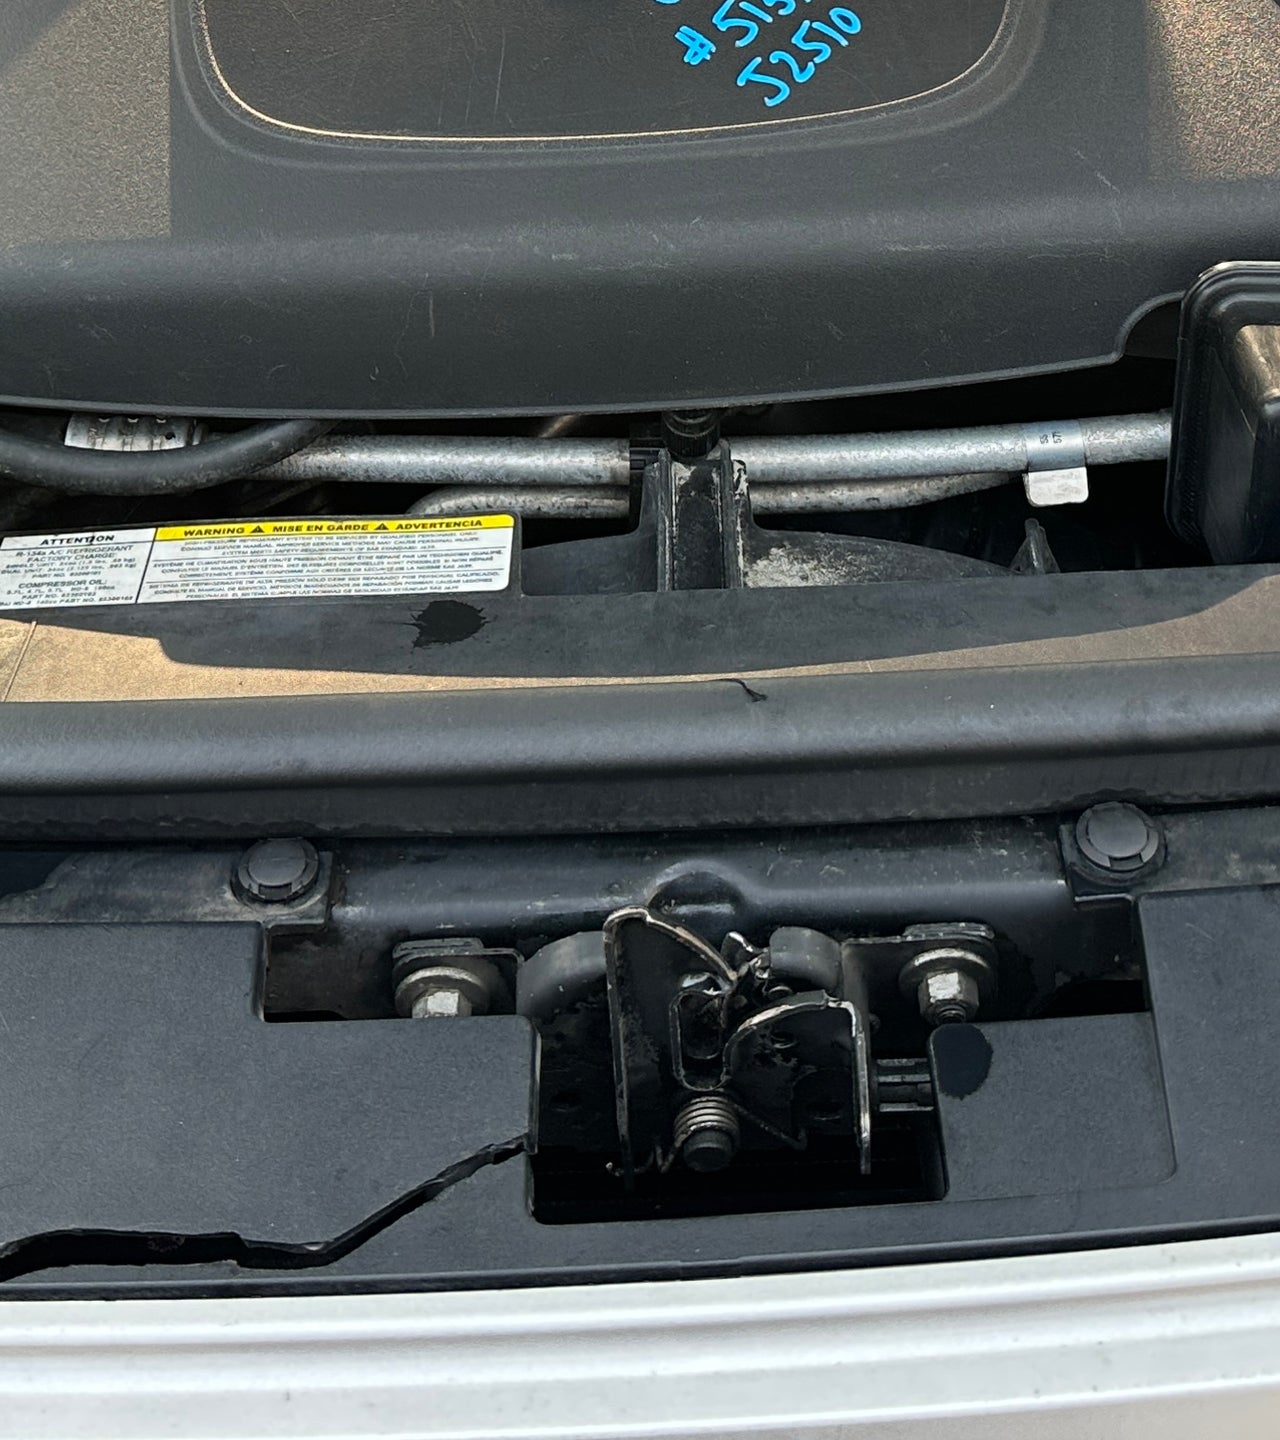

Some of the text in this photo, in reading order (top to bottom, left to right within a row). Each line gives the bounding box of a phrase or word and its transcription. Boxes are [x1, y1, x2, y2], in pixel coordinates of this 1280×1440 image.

[183, 520, 483, 537] WARNING MISE EN GARDE ADVERTENCIA
[41, 535, 115, 546] ATTENTION
